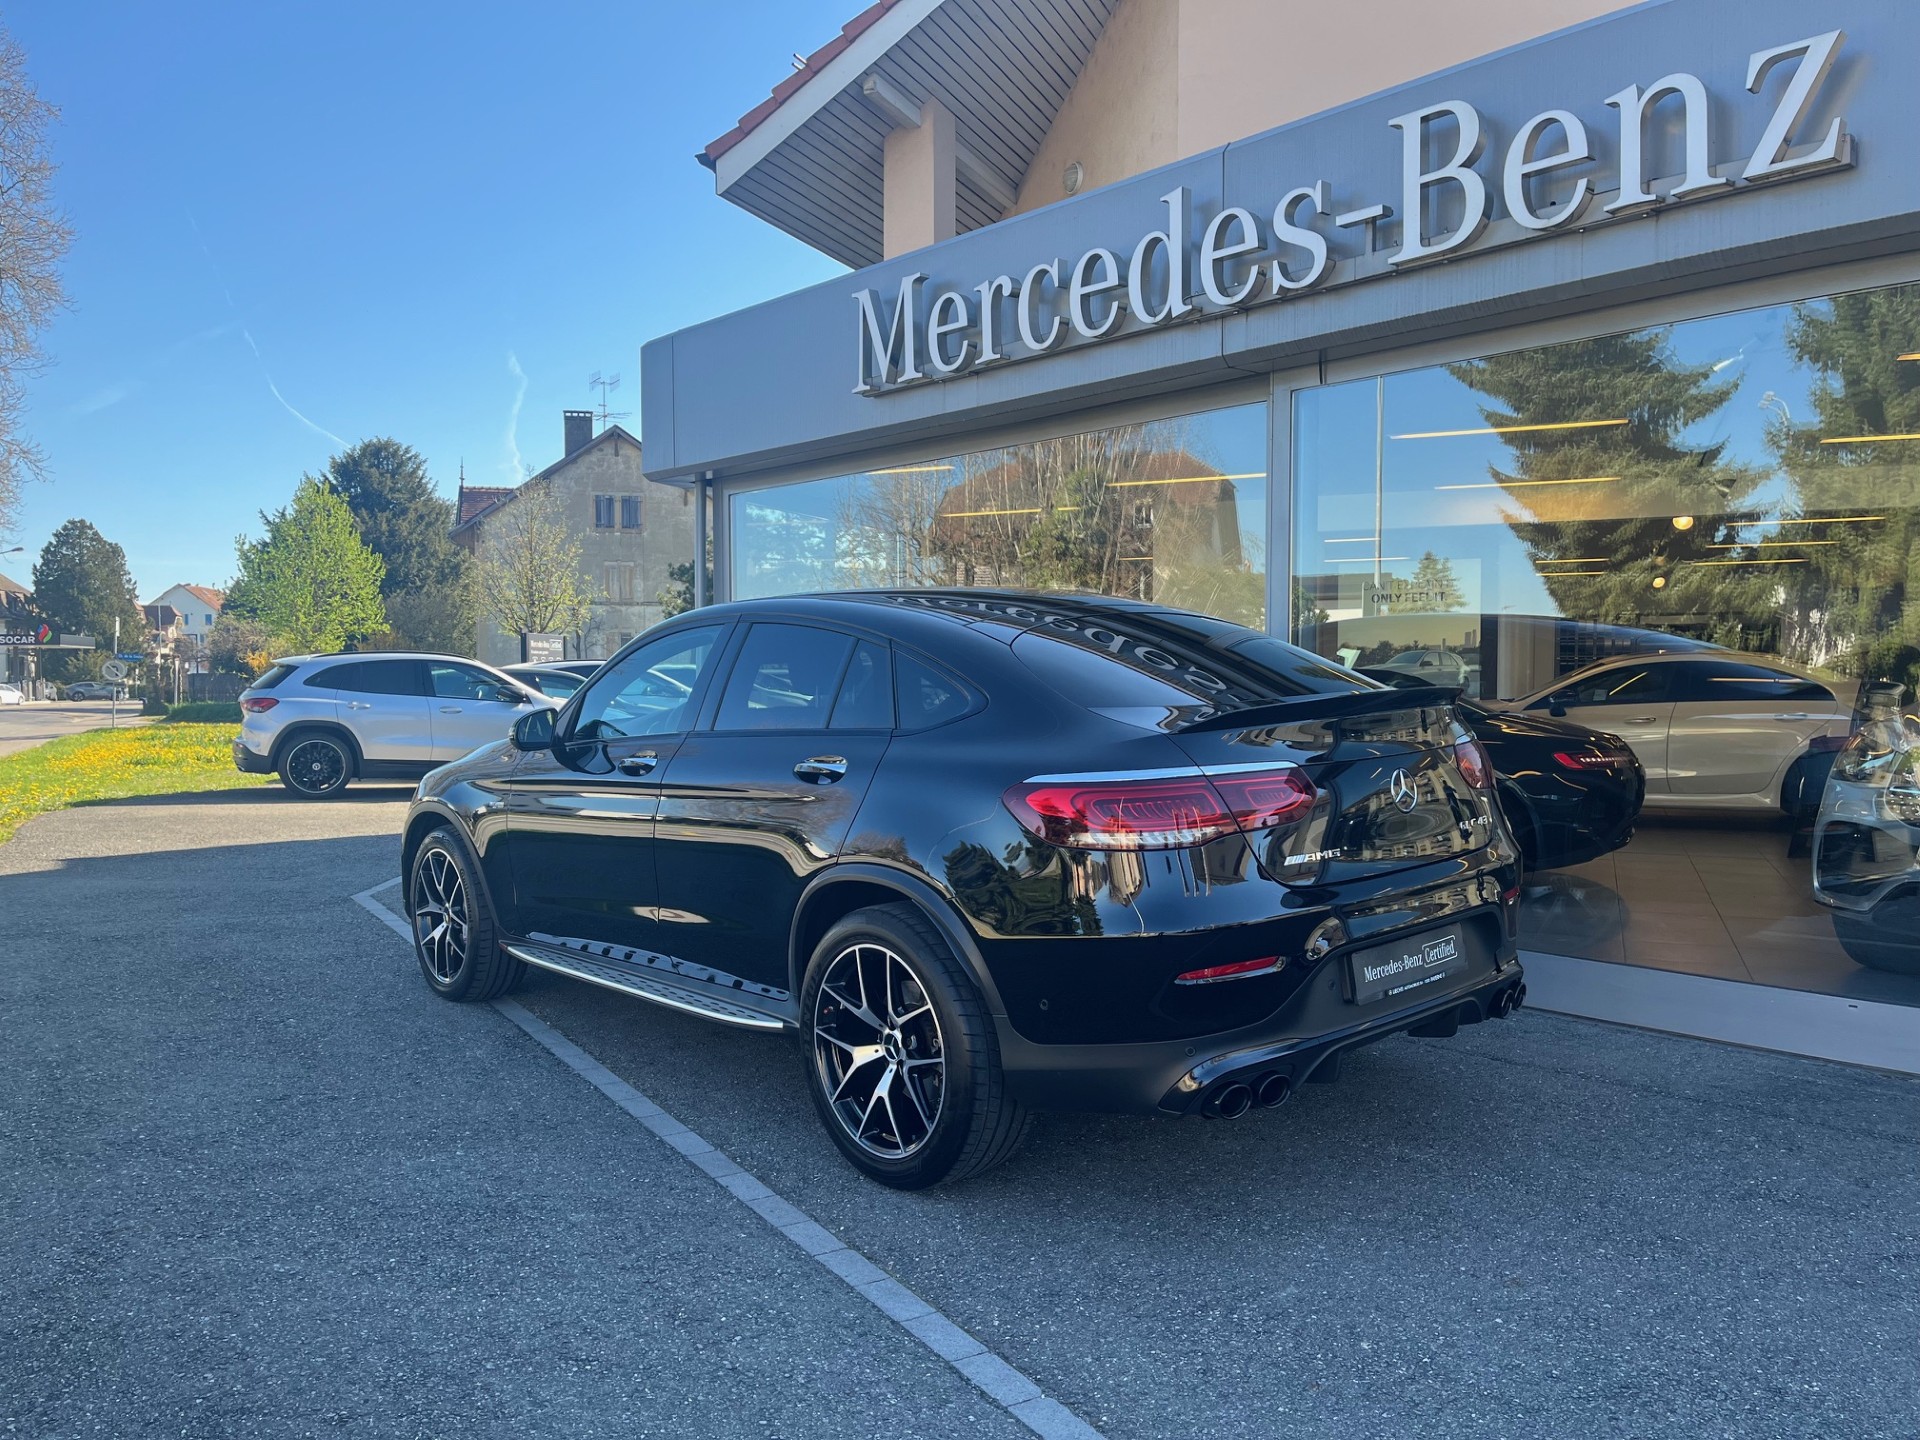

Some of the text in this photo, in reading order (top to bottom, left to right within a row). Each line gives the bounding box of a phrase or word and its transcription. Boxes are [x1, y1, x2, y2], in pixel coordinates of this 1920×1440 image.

[852, 29, 1847, 394] Mercedes-Benz
[1371, 593, 1402, 604] ONLY
[0, 635, 35, 643] SOCAR
[1364, 940, 1455, 983] Mercedes-Benz Certified
